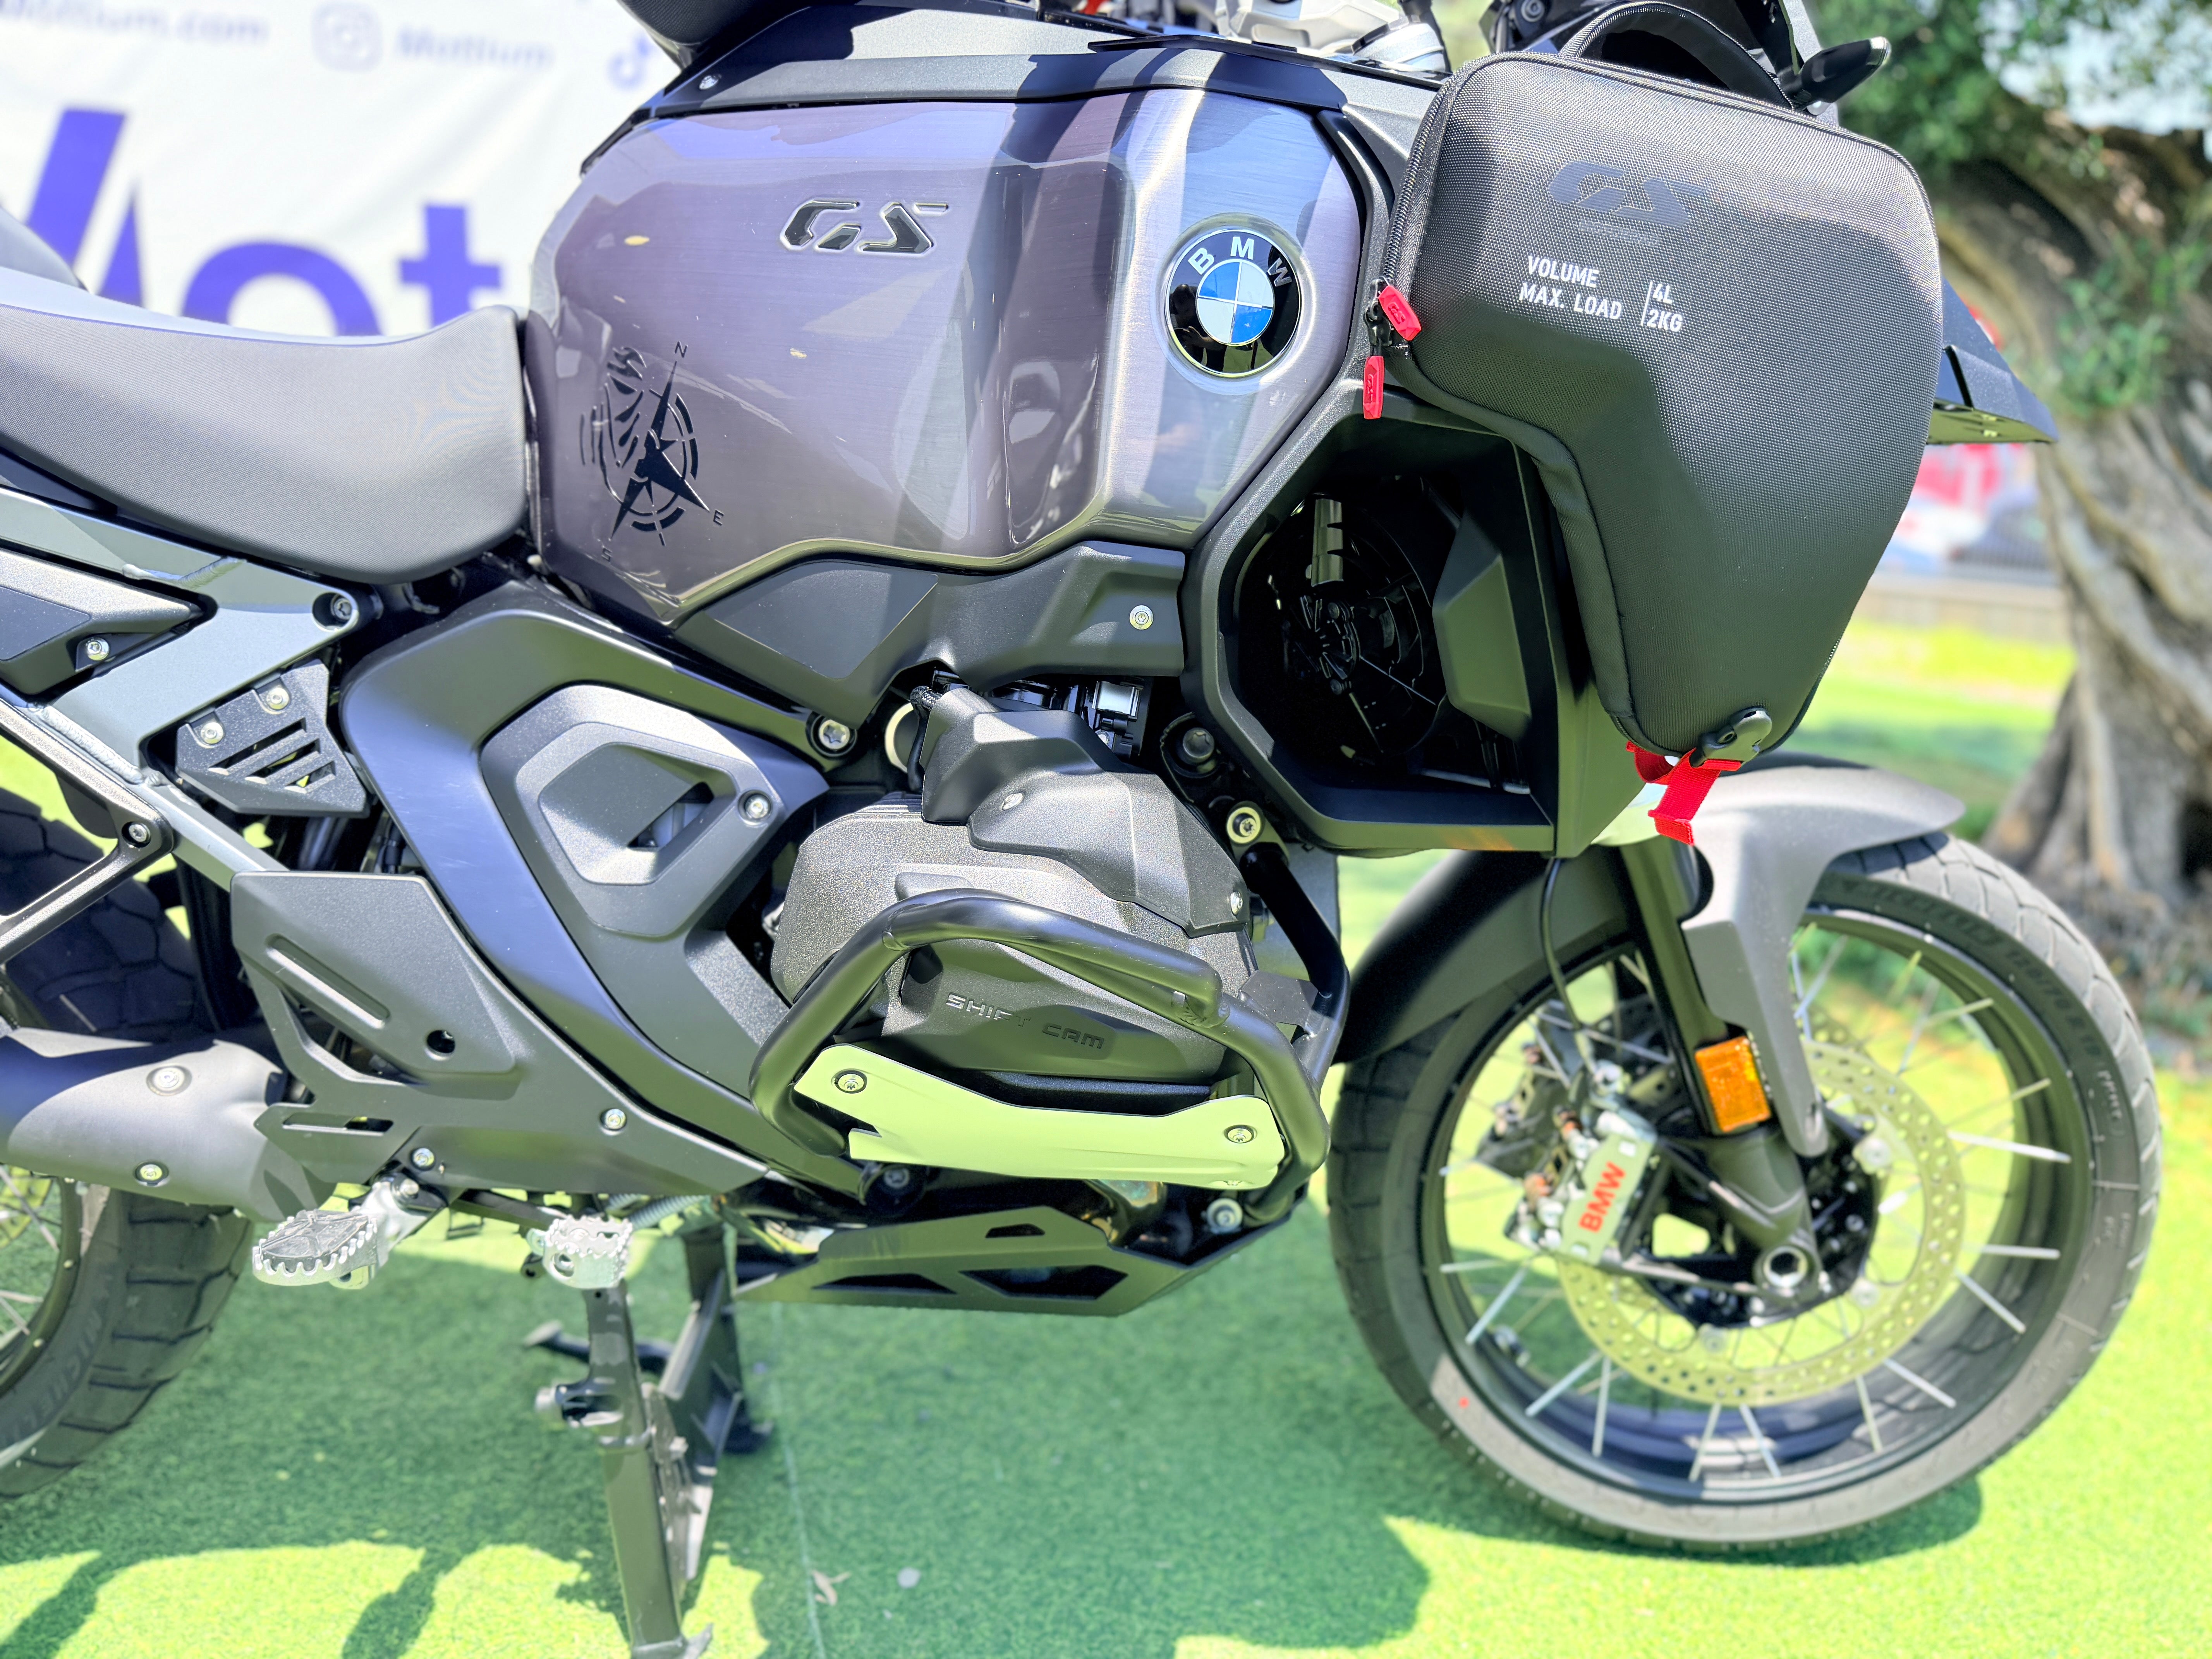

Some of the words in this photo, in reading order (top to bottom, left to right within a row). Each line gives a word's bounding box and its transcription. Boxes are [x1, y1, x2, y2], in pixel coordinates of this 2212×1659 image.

[1549, 161, 1709, 228] GS
[780, 198, 950, 256] GS
[1188, 236, 1292, 287] BMW
[1528, 256, 1600, 288] VOLUME
[1652, 283, 1673, 304] 4L
[1518, 282, 1565, 309] MAX.
[1573, 293, 1623, 320] LOAD
[1647, 309, 1683, 332] 2KG
[675, 341, 688, 358] N
[713, 510, 725, 526] E
[601, 546, 612, 562] S
[946, 993, 1031, 1027] SHIFT
[1042, 1022, 1104, 1049] CAM
[1578, 1161, 1625, 1233] BMW
